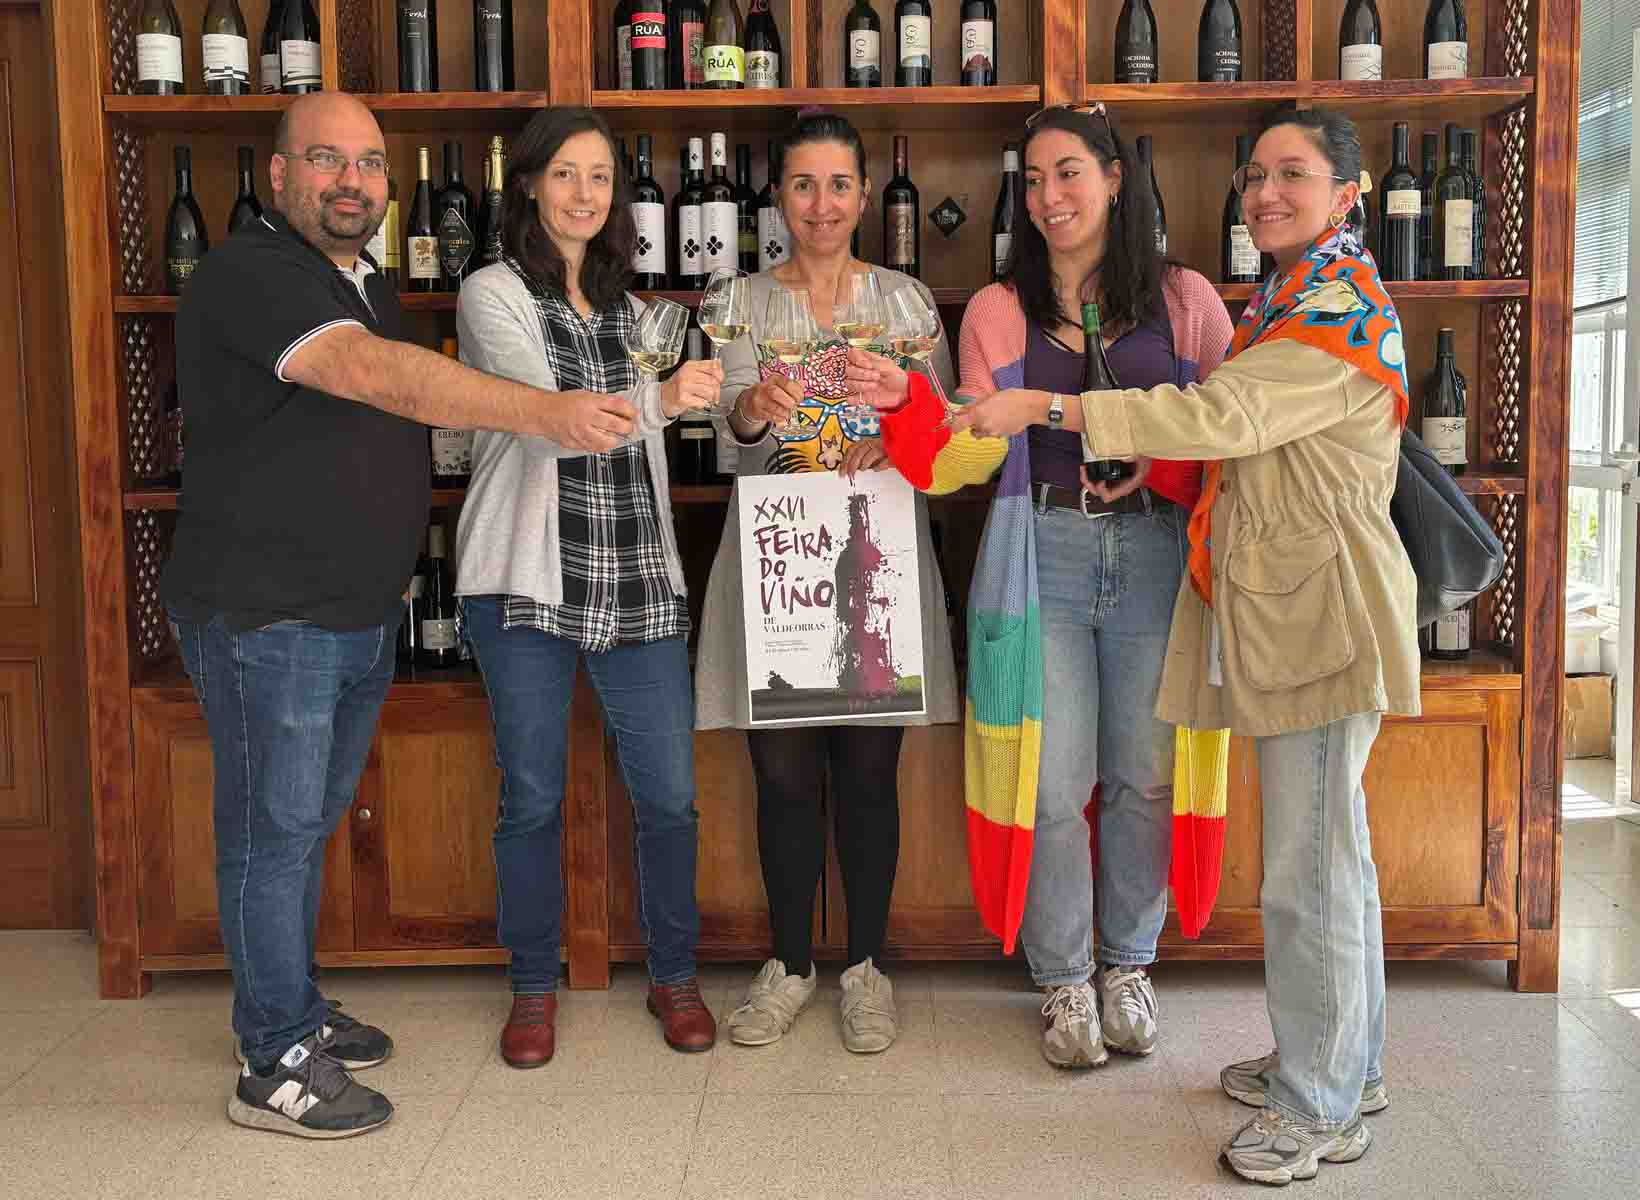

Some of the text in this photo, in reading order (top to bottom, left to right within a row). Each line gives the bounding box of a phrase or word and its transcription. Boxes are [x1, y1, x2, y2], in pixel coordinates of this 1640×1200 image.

[753, 496, 805, 523] XXVI
[752, 523, 832, 559] FEIRA
[760, 577, 835, 616] VIÑO
[763, 616, 777, 625] DE
[763, 623, 826, 633] VALDEORRAS
